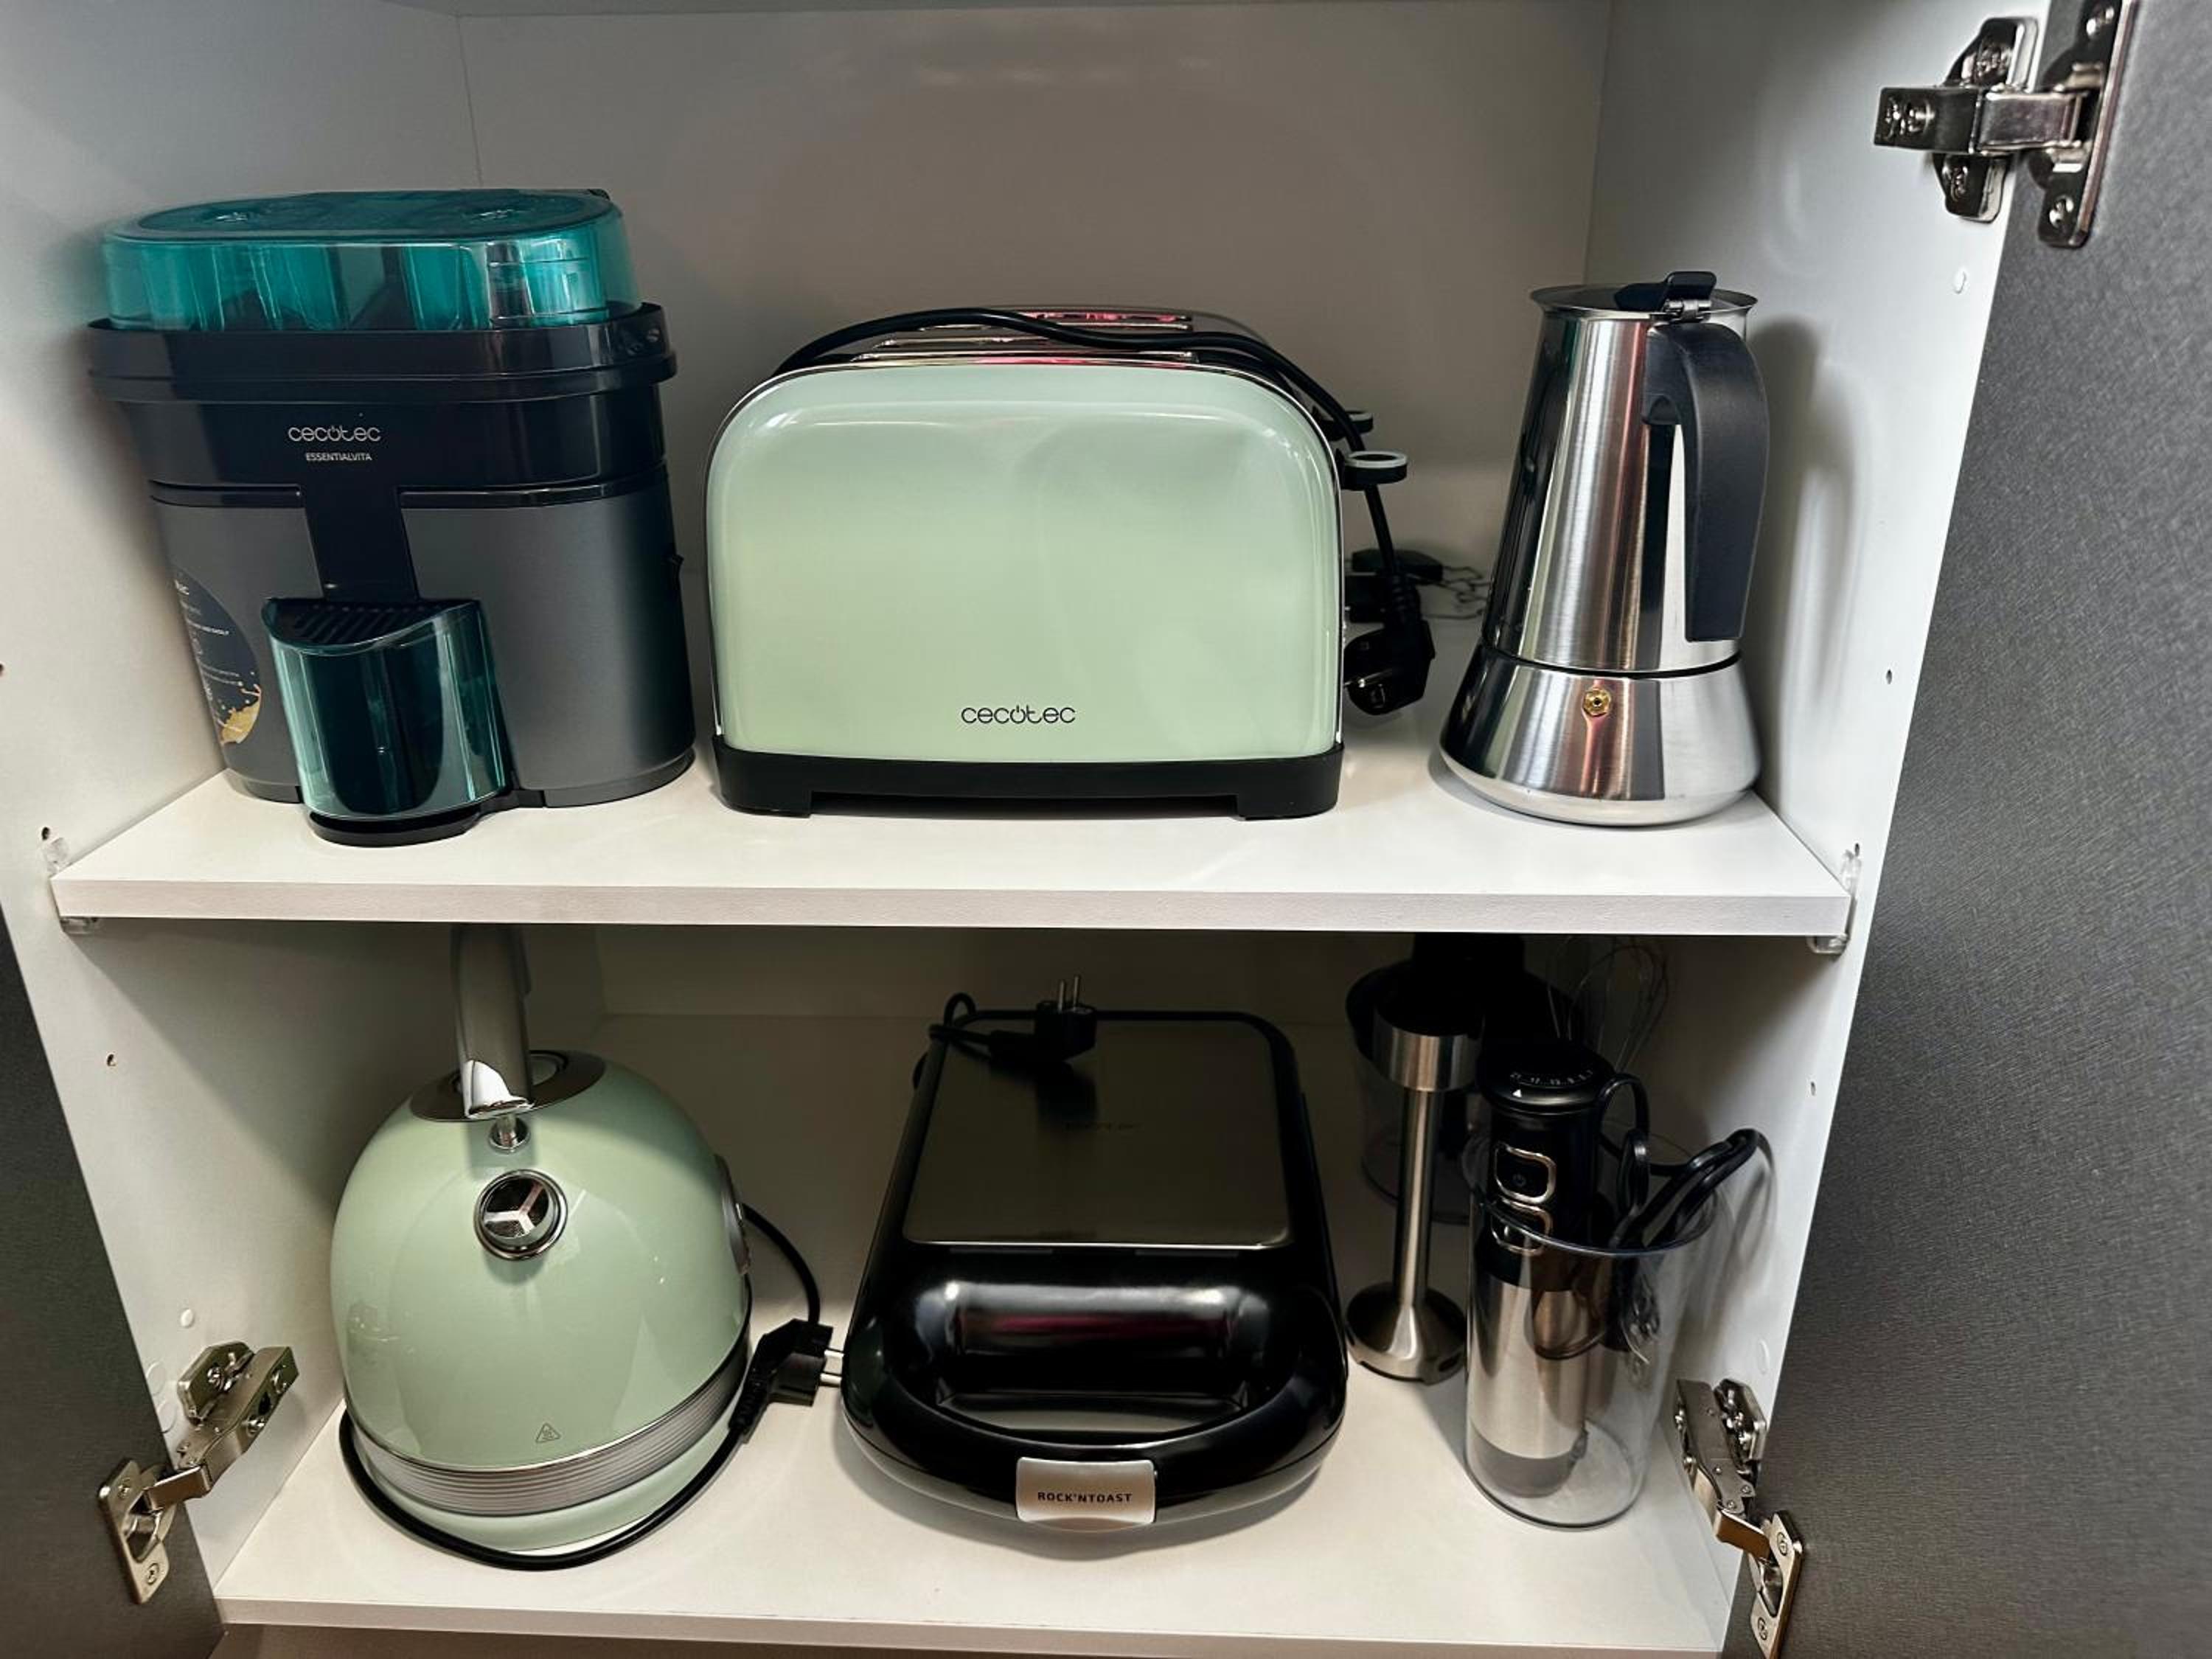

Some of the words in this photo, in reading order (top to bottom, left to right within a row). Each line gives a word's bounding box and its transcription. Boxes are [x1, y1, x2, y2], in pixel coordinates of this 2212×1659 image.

[288, 425, 381, 442] cecotec
[305, 452, 372, 462] ESSENTIALVITA
[961, 704, 1076, 724] cecotec
[1037, 1491, 1133, 1503] ROCK'NTOAST
